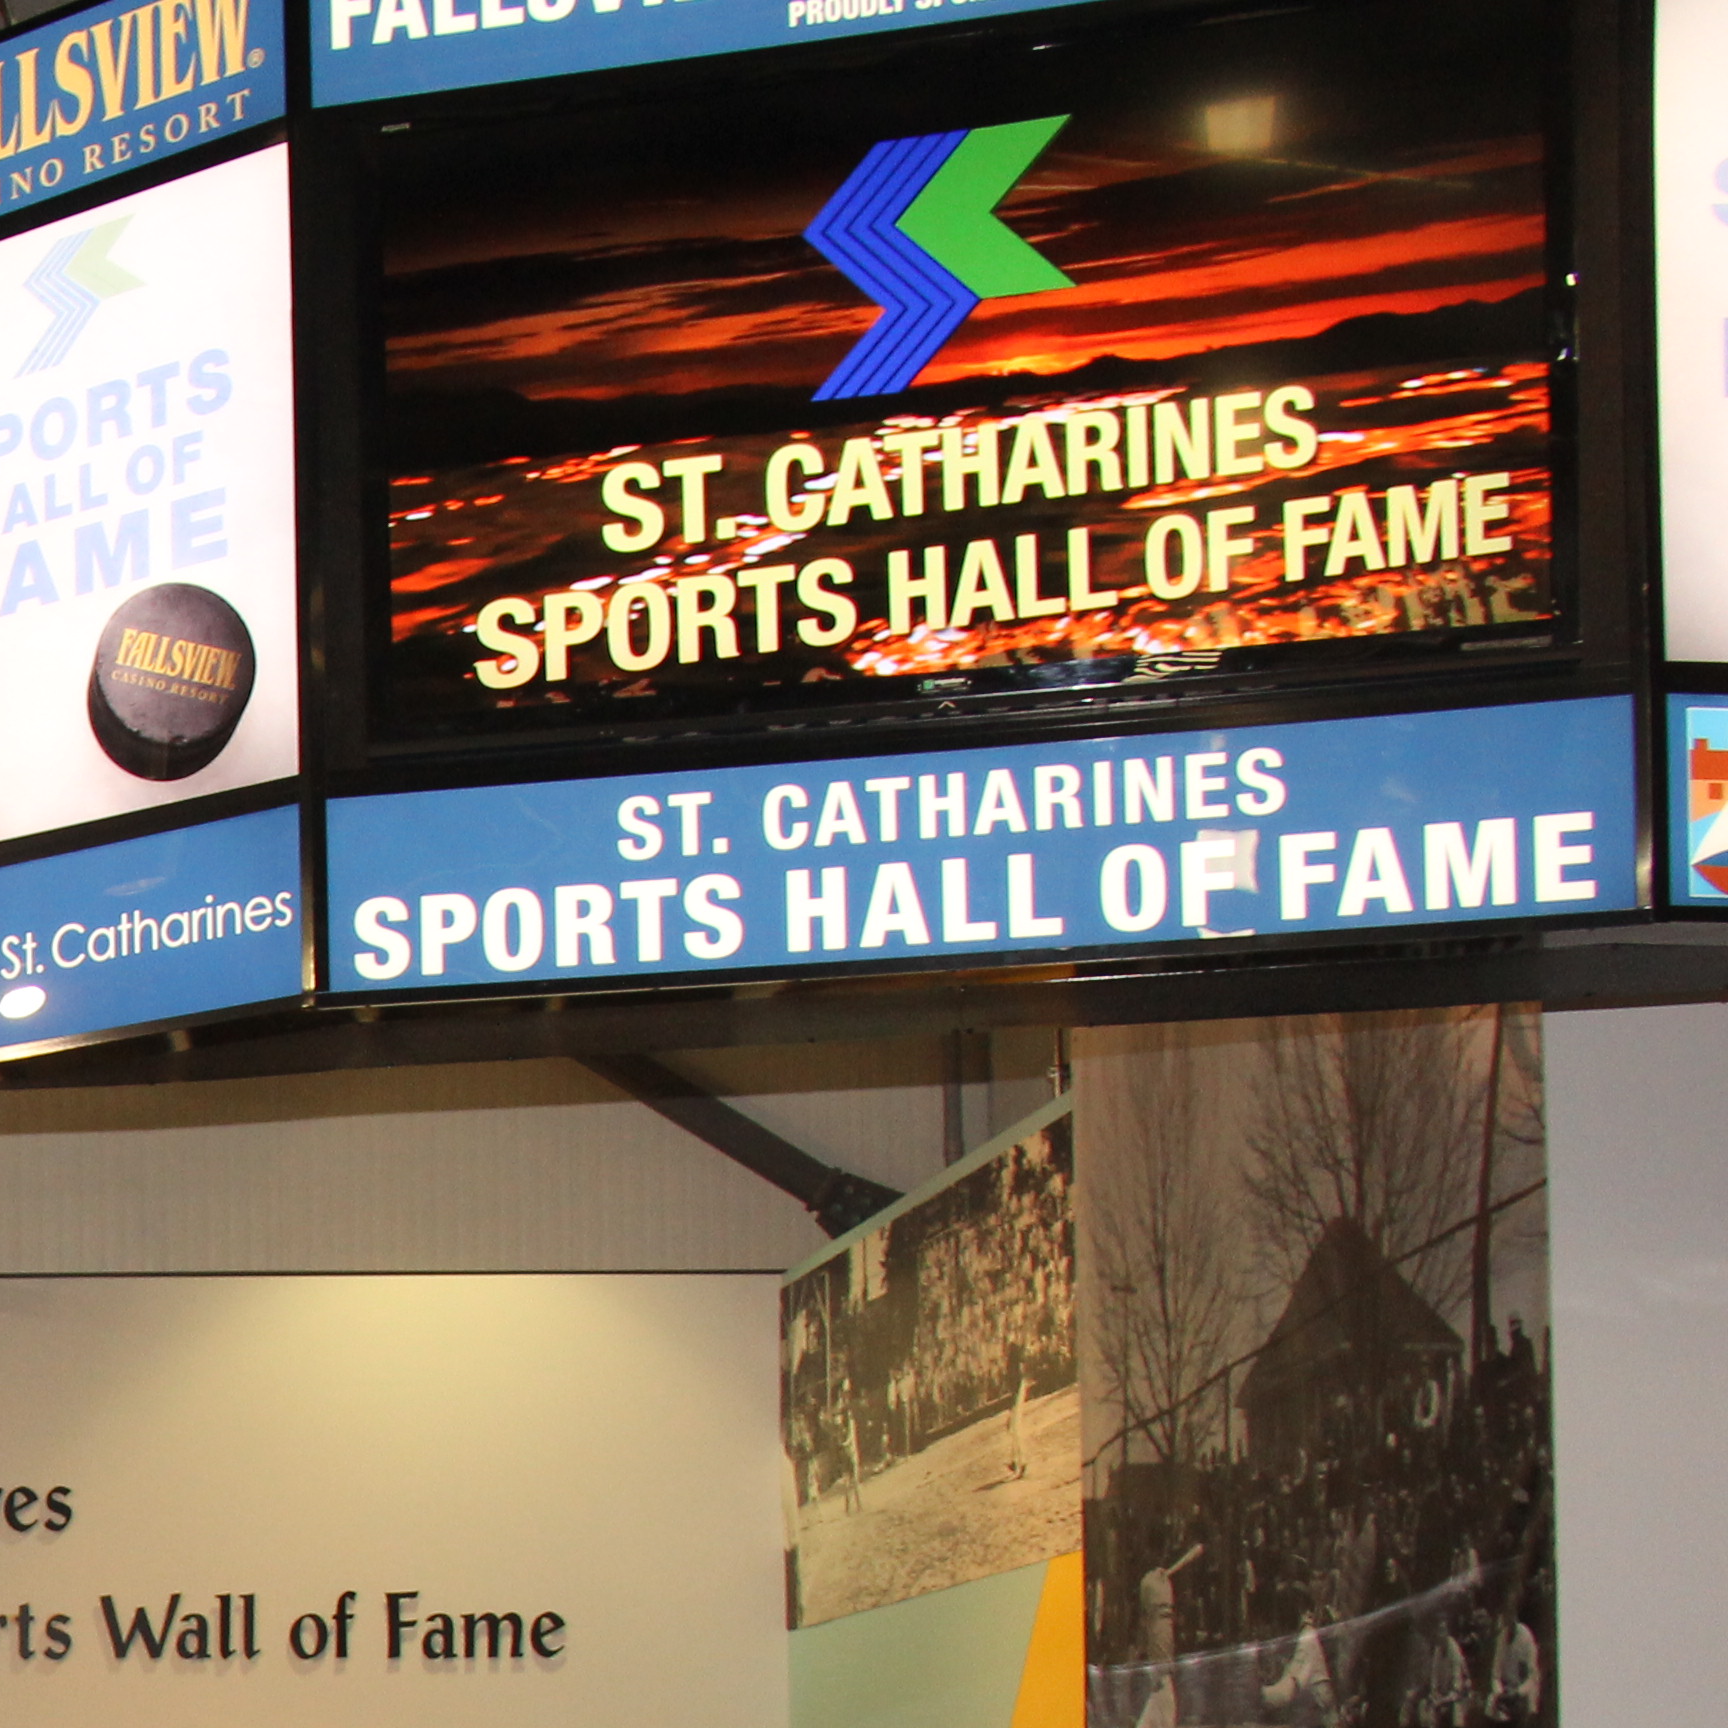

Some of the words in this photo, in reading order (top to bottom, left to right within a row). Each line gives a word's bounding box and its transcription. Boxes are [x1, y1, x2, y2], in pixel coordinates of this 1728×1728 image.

[82, 88, 252, 175] RESORT
[125, 428, 204, 497] OF
[602, 456, 739, 553] ST.
[764, 384, 1318, 533] CATHARINES
[474, 558, 858, 690] SPORTS
[887, 525, 1121, 636] HALL
[1146, 505, 1259, 600] OF
[1282, 471, 1514, 583] FAME
[111, 669, 166, 691] CASINO
[115, 627, 242, 690] FALLSVIEW
[615, 792, 729, 862] ST.
[762, 746, 1287, 852] CATHARINES
[0, 932, 45, 980] St.
[51, 891, 294, 969] Catharines
[352, 872, 744, 981] SPORTS
[785, 852, 1064, 952] HALL
[1099, 840, 1236, 934] OF
[1279, 810, 1598, 920] FAME
[100, 1593, 261, 1661] Wall
[289, 1591, 357, 1661] of
[385, 1590, 567, 1661] Fame
